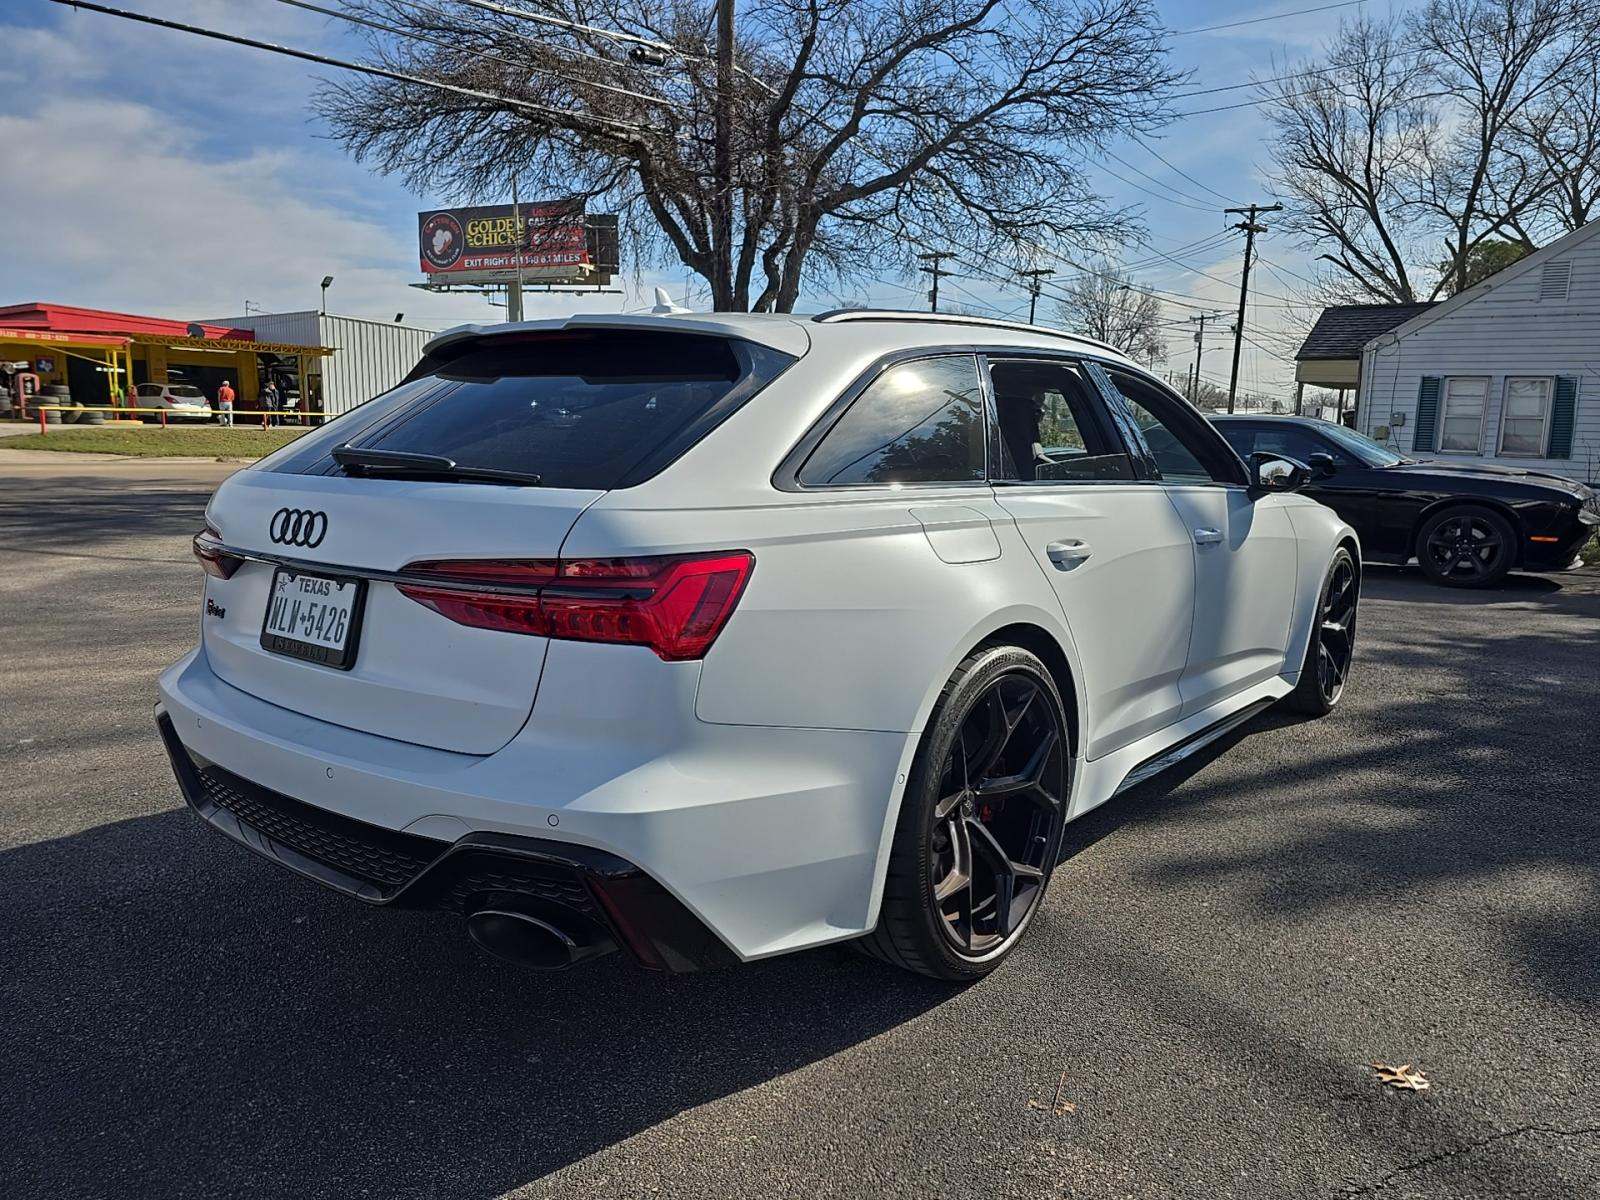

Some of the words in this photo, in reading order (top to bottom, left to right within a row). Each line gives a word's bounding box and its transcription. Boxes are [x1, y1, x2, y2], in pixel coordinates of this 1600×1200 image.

[468, 217, 524, 236] GOLDEN
[464, 258, 482, 268] EXIT
[484, 256, 509, 266] RIGHT
[299, 578, 331, 596] TEXAS
